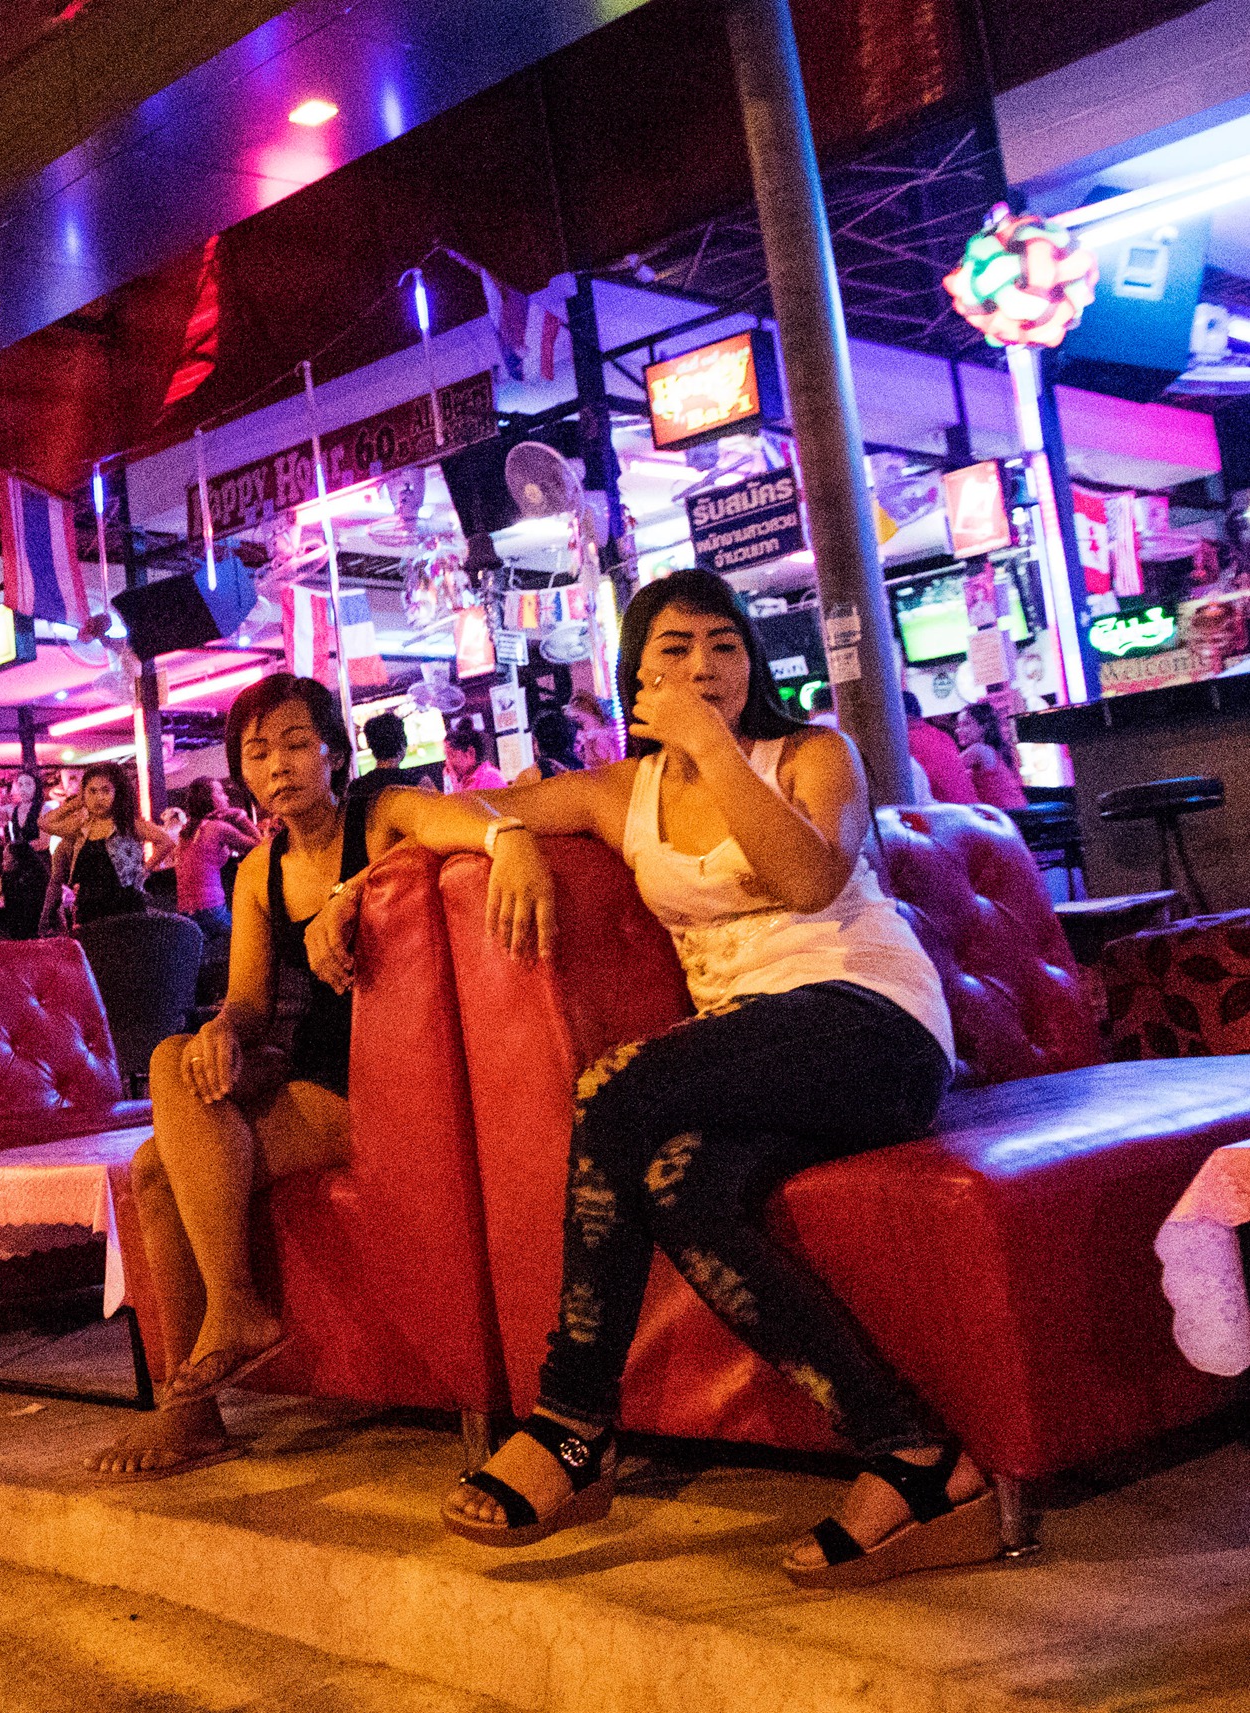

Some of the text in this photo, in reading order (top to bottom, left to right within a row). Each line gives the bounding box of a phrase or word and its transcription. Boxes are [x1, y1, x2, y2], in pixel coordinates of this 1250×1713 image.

[354, 423, 397, 470] 60
[692, 477, 793, 526] รับสมัคร
